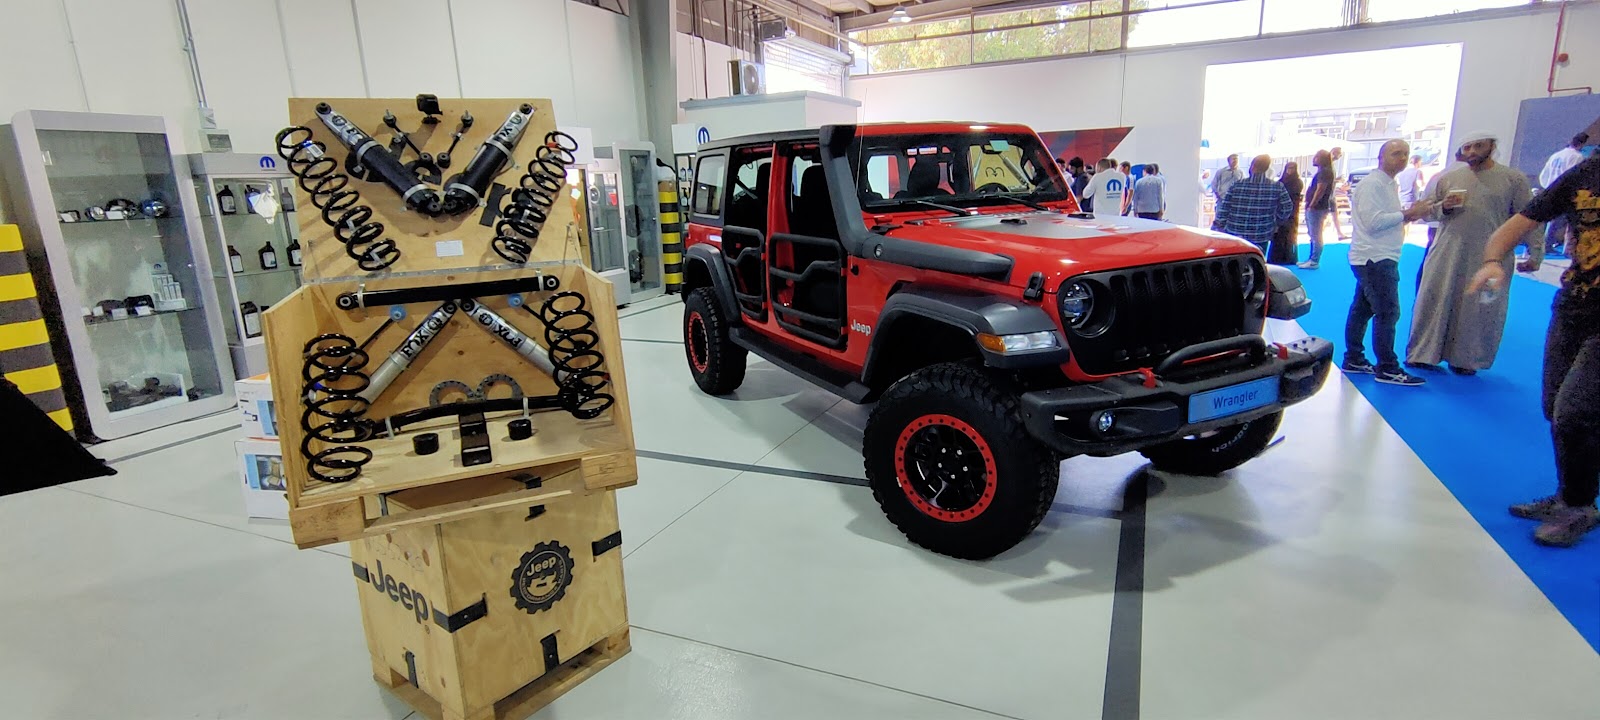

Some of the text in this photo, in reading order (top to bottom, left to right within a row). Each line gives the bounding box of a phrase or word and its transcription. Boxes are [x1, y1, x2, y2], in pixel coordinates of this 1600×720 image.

[493, 322, 523, 348] FOX
[851, 319, 871, 336] Jeep
[401, 329, 429, 358] FOX
[1213, 390, 1258, 409] Wrangler
[527, 556, 557, 577] Jeep
[370, 559, 428, 624] Jeep
